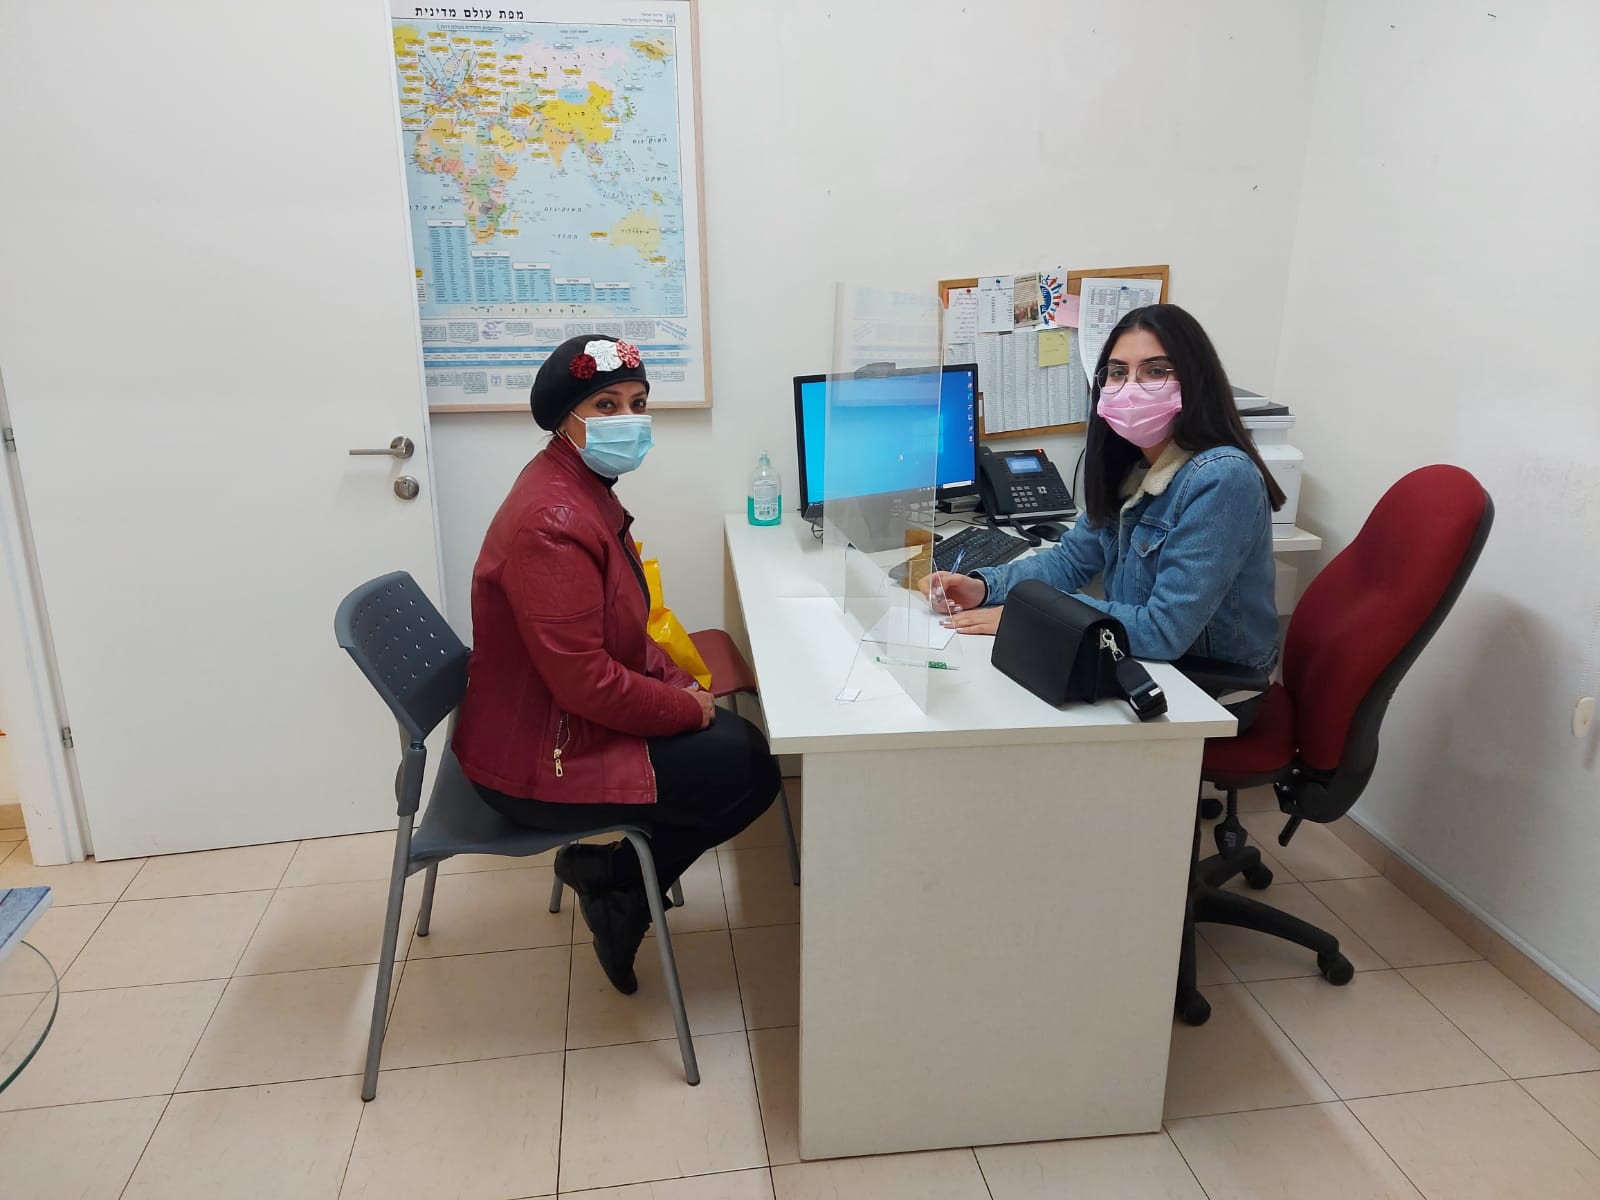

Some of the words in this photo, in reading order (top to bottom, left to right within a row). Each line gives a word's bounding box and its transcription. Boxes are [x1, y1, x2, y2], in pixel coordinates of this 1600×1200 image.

[415, 7, 456, 17] מדינית
[464, 8, 492, 19] עולם
[499, 10, 524, 19] מפת
